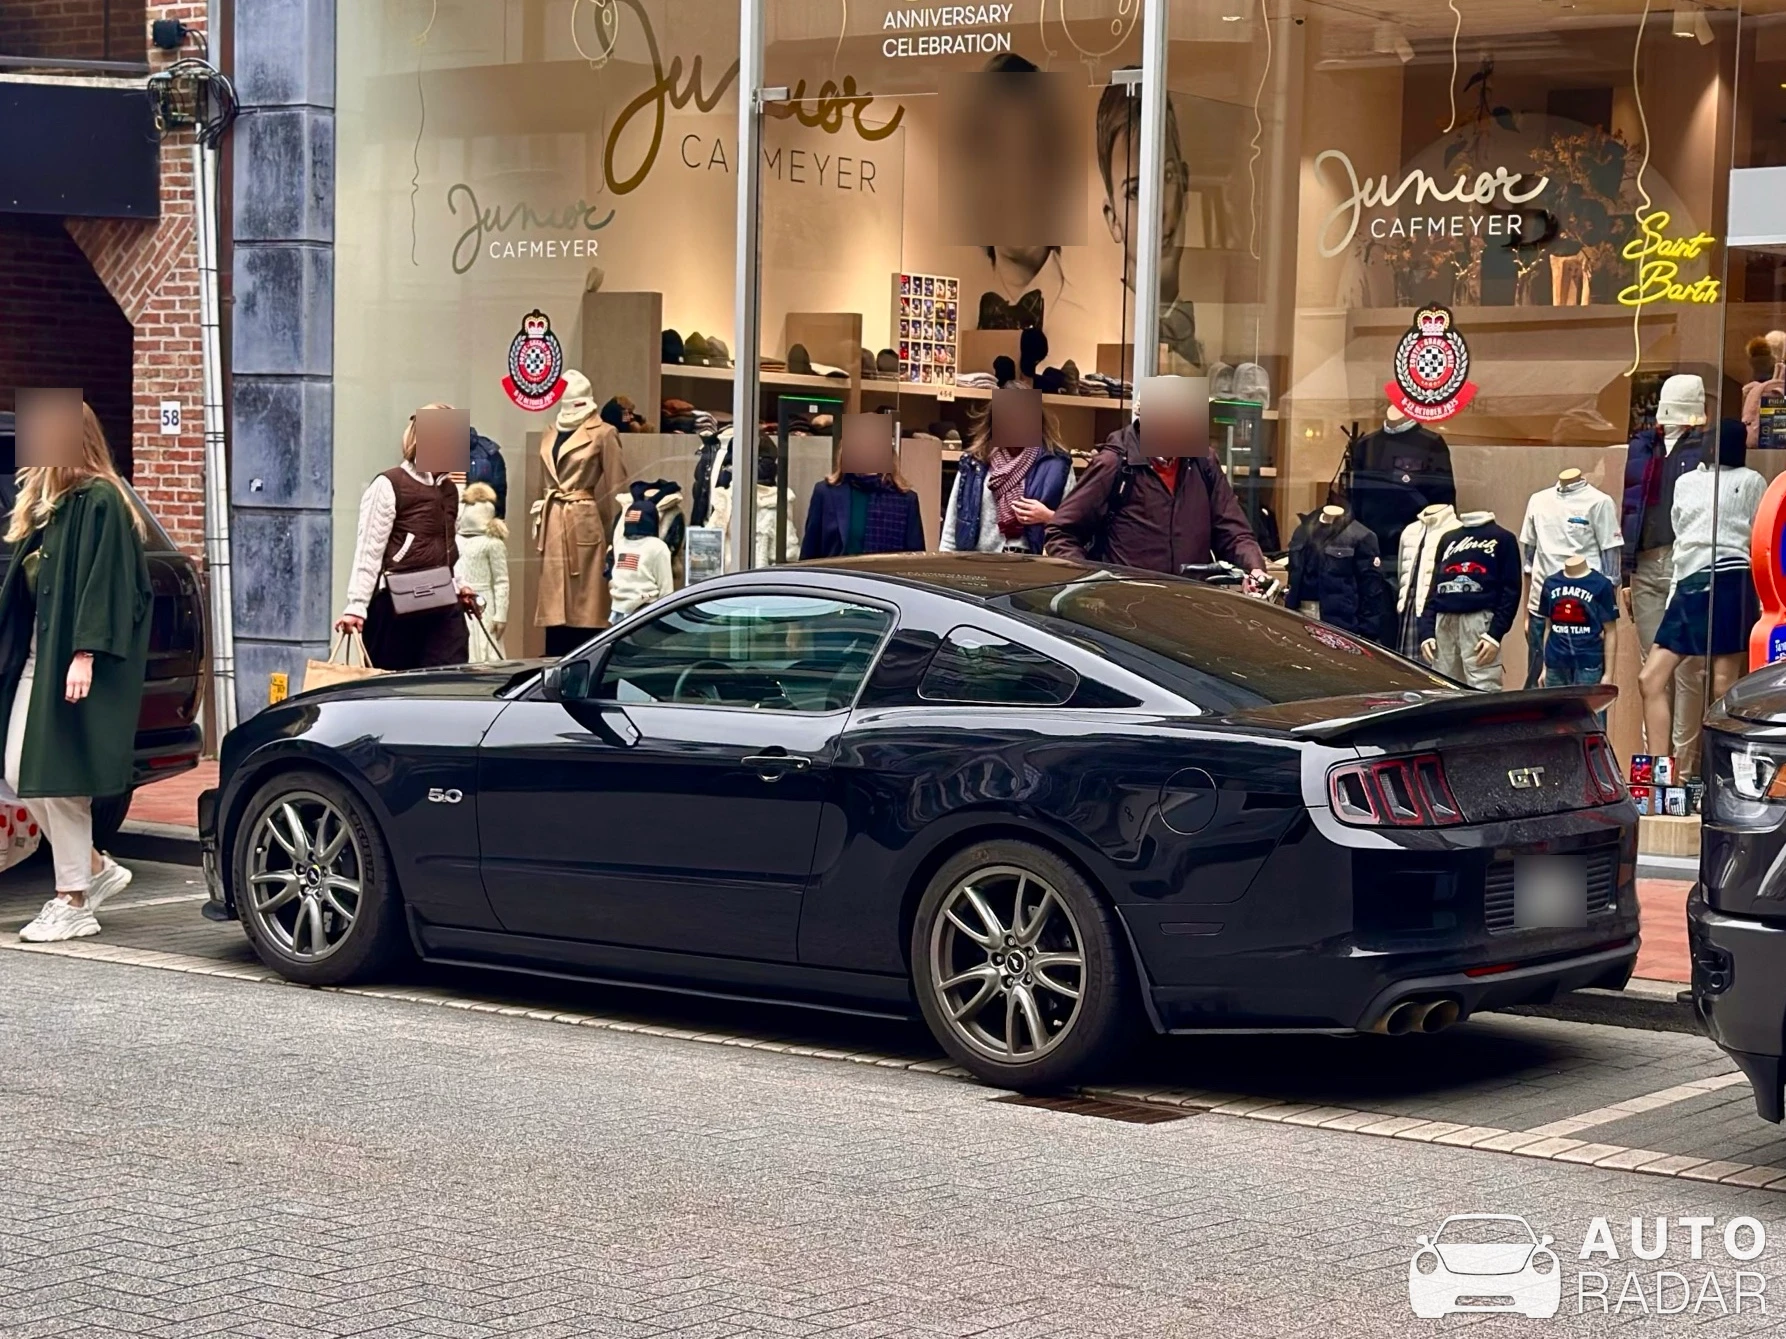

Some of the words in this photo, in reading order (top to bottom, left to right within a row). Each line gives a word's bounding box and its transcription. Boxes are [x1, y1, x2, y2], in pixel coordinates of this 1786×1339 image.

[882, 3, 1014, 31] ANNIVERSARY
[882, 31, 1012, 58] CELEBRATION
[594, 0, 906, 196] Juior
[680, 133, 877, 194] CAMEYER
[1313, 148, 1550, 259] Junior
[447, 182, 616, 275] Junior
[1370, 213, 1523, 239] CAFMEYER
[1622, 210, 1716, 260] Saint
[489, 239, 599, 259] CAFMEYER
[1617, 260, 1721, 306] Barth
[162, 409, 180, 427] 58
[1550, 587, 1562, 600] ST
[1562, 585, 1594, 603] BARTH
[1570, 625, 1591, 635] TEAM
[1507, 766, 1545, 789] GT
[427, 787, 463, 804] 5.0
